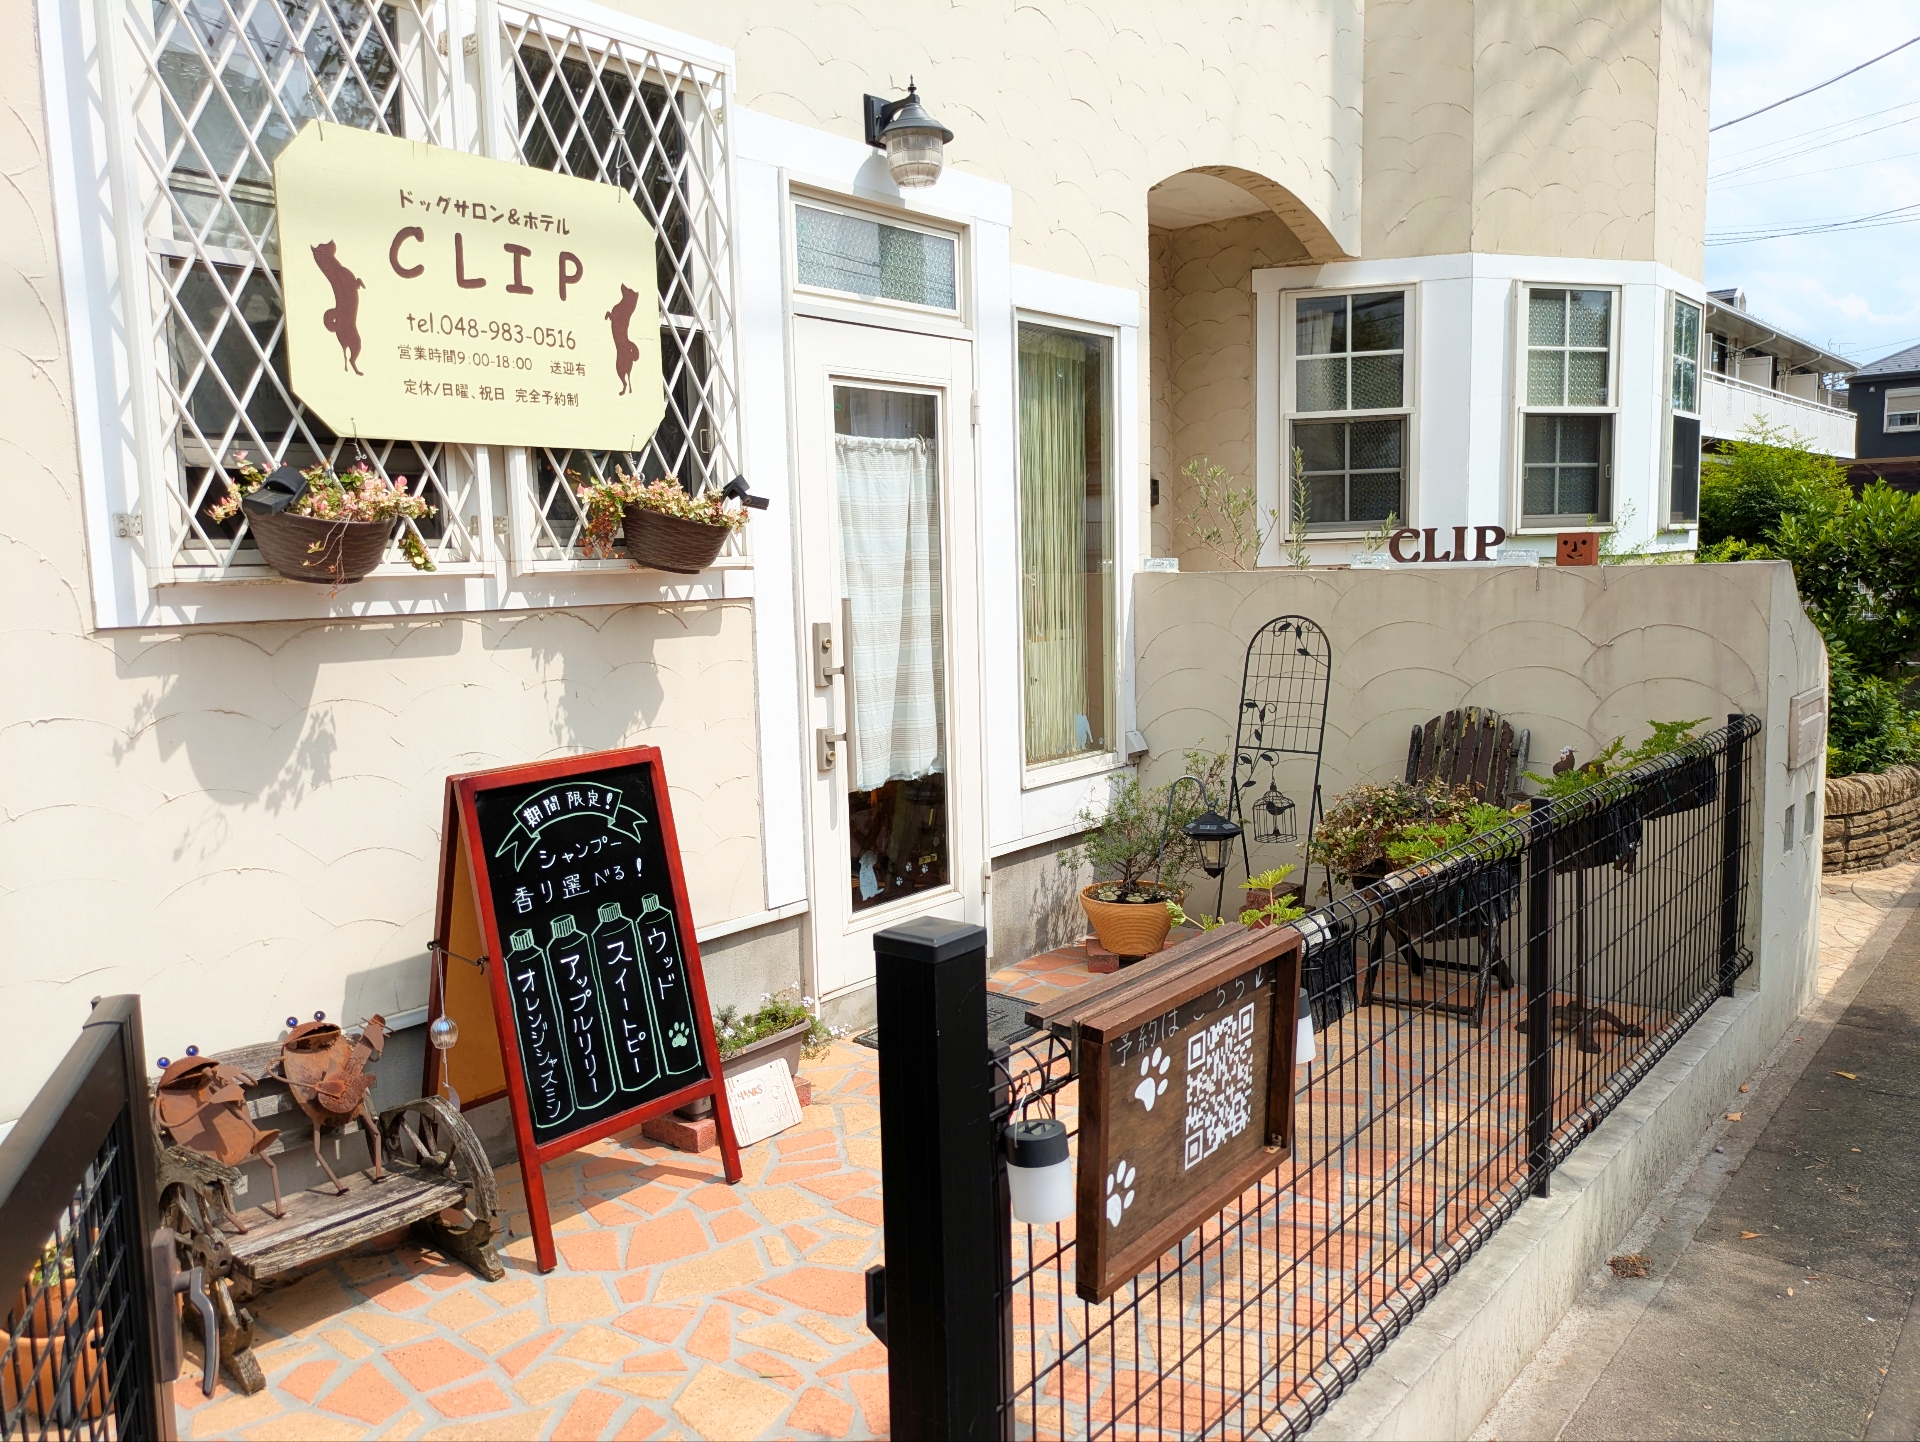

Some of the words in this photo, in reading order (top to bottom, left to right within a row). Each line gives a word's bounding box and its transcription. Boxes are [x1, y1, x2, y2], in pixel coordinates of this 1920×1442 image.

[399, 188, 571, 236] ドッグサロン&ホテル
[388, 225, 584, 302] CLIP
[406, 312, 577, 351] tel.048-983-0516
[549, 359, 587, 377] 送迎有
[403, 378, 505, 401] 定休/日曜、祝日
[515, 387, 580, 408] 完全予約制
[1388, 524, 1506, 564] CLIP
[539, 835, 622, 869] シャンプー
[647, 927, 676, 1000] ウッド
[560, 954, 598, 1093] アップルリリー
[607, 940, 647, 1074] スイートピー
